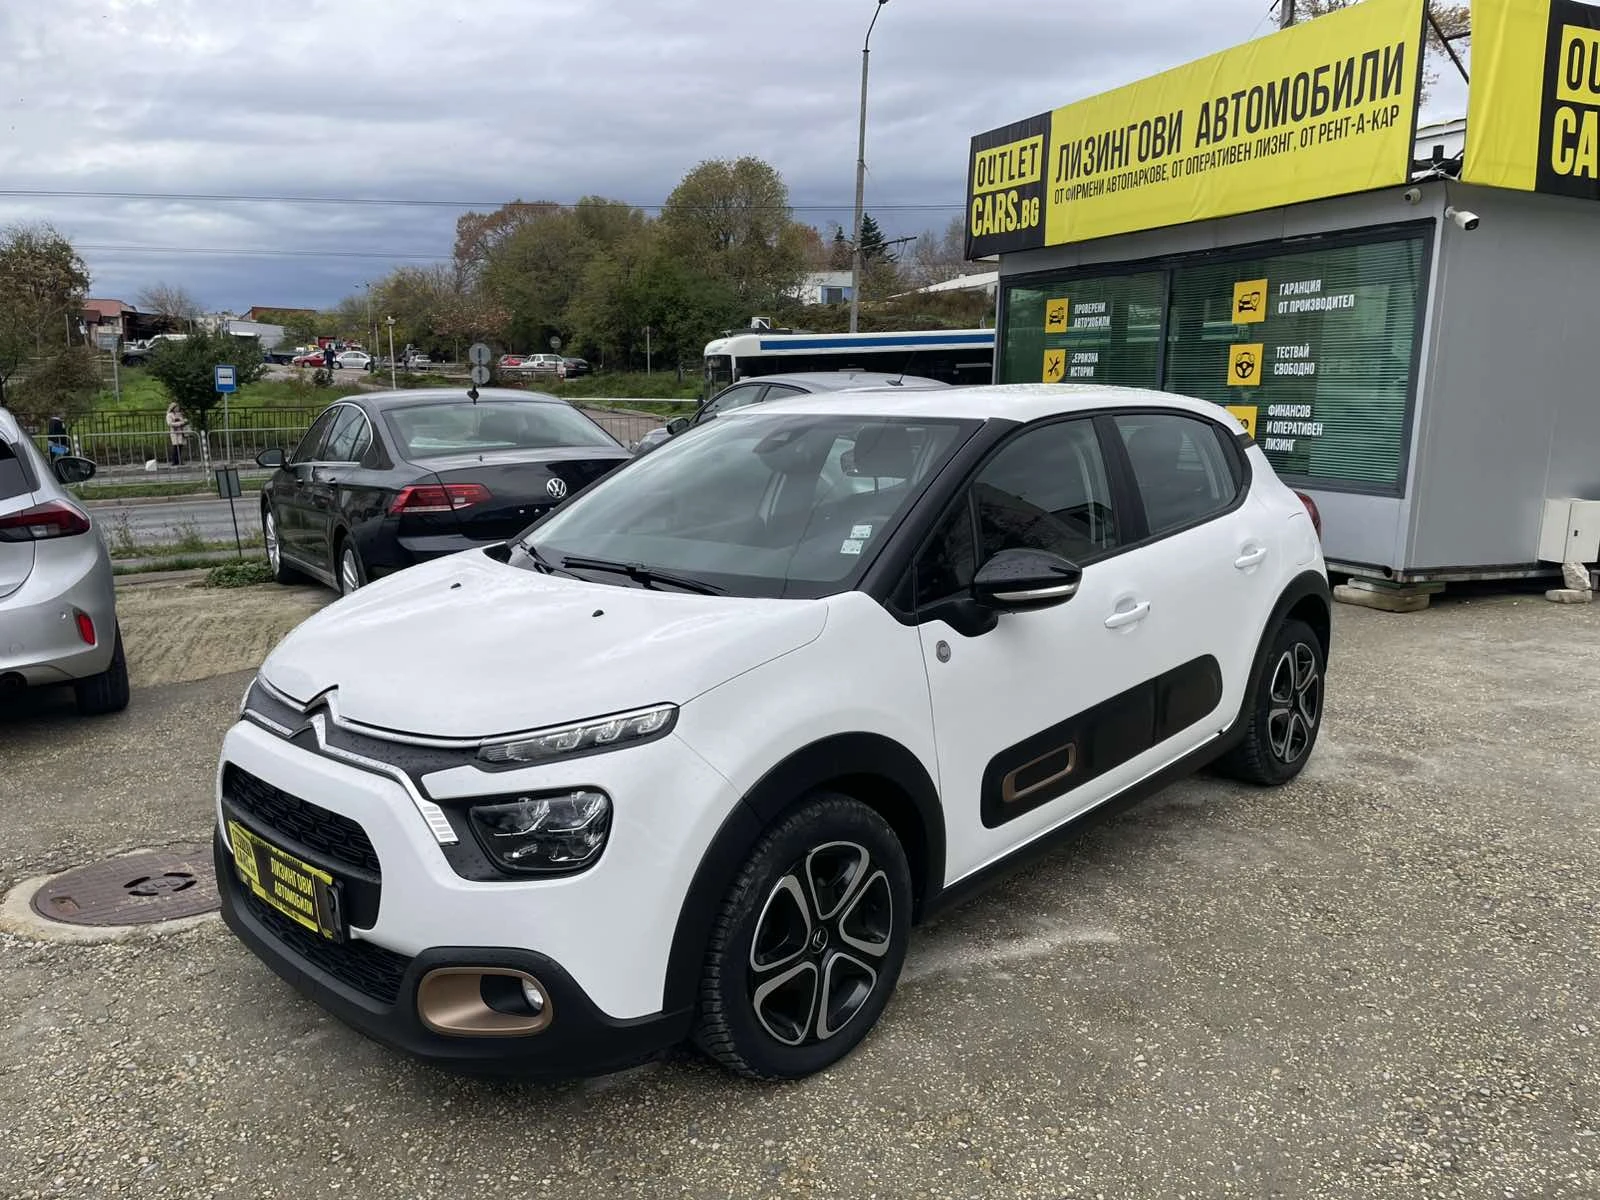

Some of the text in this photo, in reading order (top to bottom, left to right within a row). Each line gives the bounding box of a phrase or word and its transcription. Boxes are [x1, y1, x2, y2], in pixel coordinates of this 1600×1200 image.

[1055, 41, 1406, 184] ЛИЗИНГОВИ АВТОМОБИЛИ
[1552, 106, 1598, 179] CA
[1054, 188, 1065, 205] ОТ
[1065, 181, 1105, 202] ФИРМЕНИ
[1106, 162, 1170, 193] АВТОПАРКОВЕ,
[1171, 161, 1184, 179] ОТ
[1185, 140, 1251, 176] ОПЕРАТИВЕН
[1300, 125, 1317, 148] ОТ
[1318, 104, 1400, 145] РЕНТ-А-КАР
[977, 142, 1039, 187] OUTLET
[971, 190, 1040, 237] CARS.BG
[1279, 280, 1321, 296] ГАРАНЦИЯ
[1074, 302, 1106, 314] ПРОВЕРЕНИ
[1278, 294, 1355, 314] ОТ ПРОИЗВОДИТЕЛ
[1276, 343, 1310, 358] ТЕСТВАЙ
[1070, 366, 1094, 377] ИСТОРИЯ
[1274, 362, 1315, 376] СВОБОДНО
[1268, 404, 1311, 417] ФИНАНСОВ
[1266, 421, 1323, 436] И ОПЕРАТИВЕН
[1264, 438, 1296, 451] ЛИЗИНГ
[271, 857, 314, 897] ЛИЗИНГОВИ
[274, 880, 314, 917] АВТОМОБИЛИ
